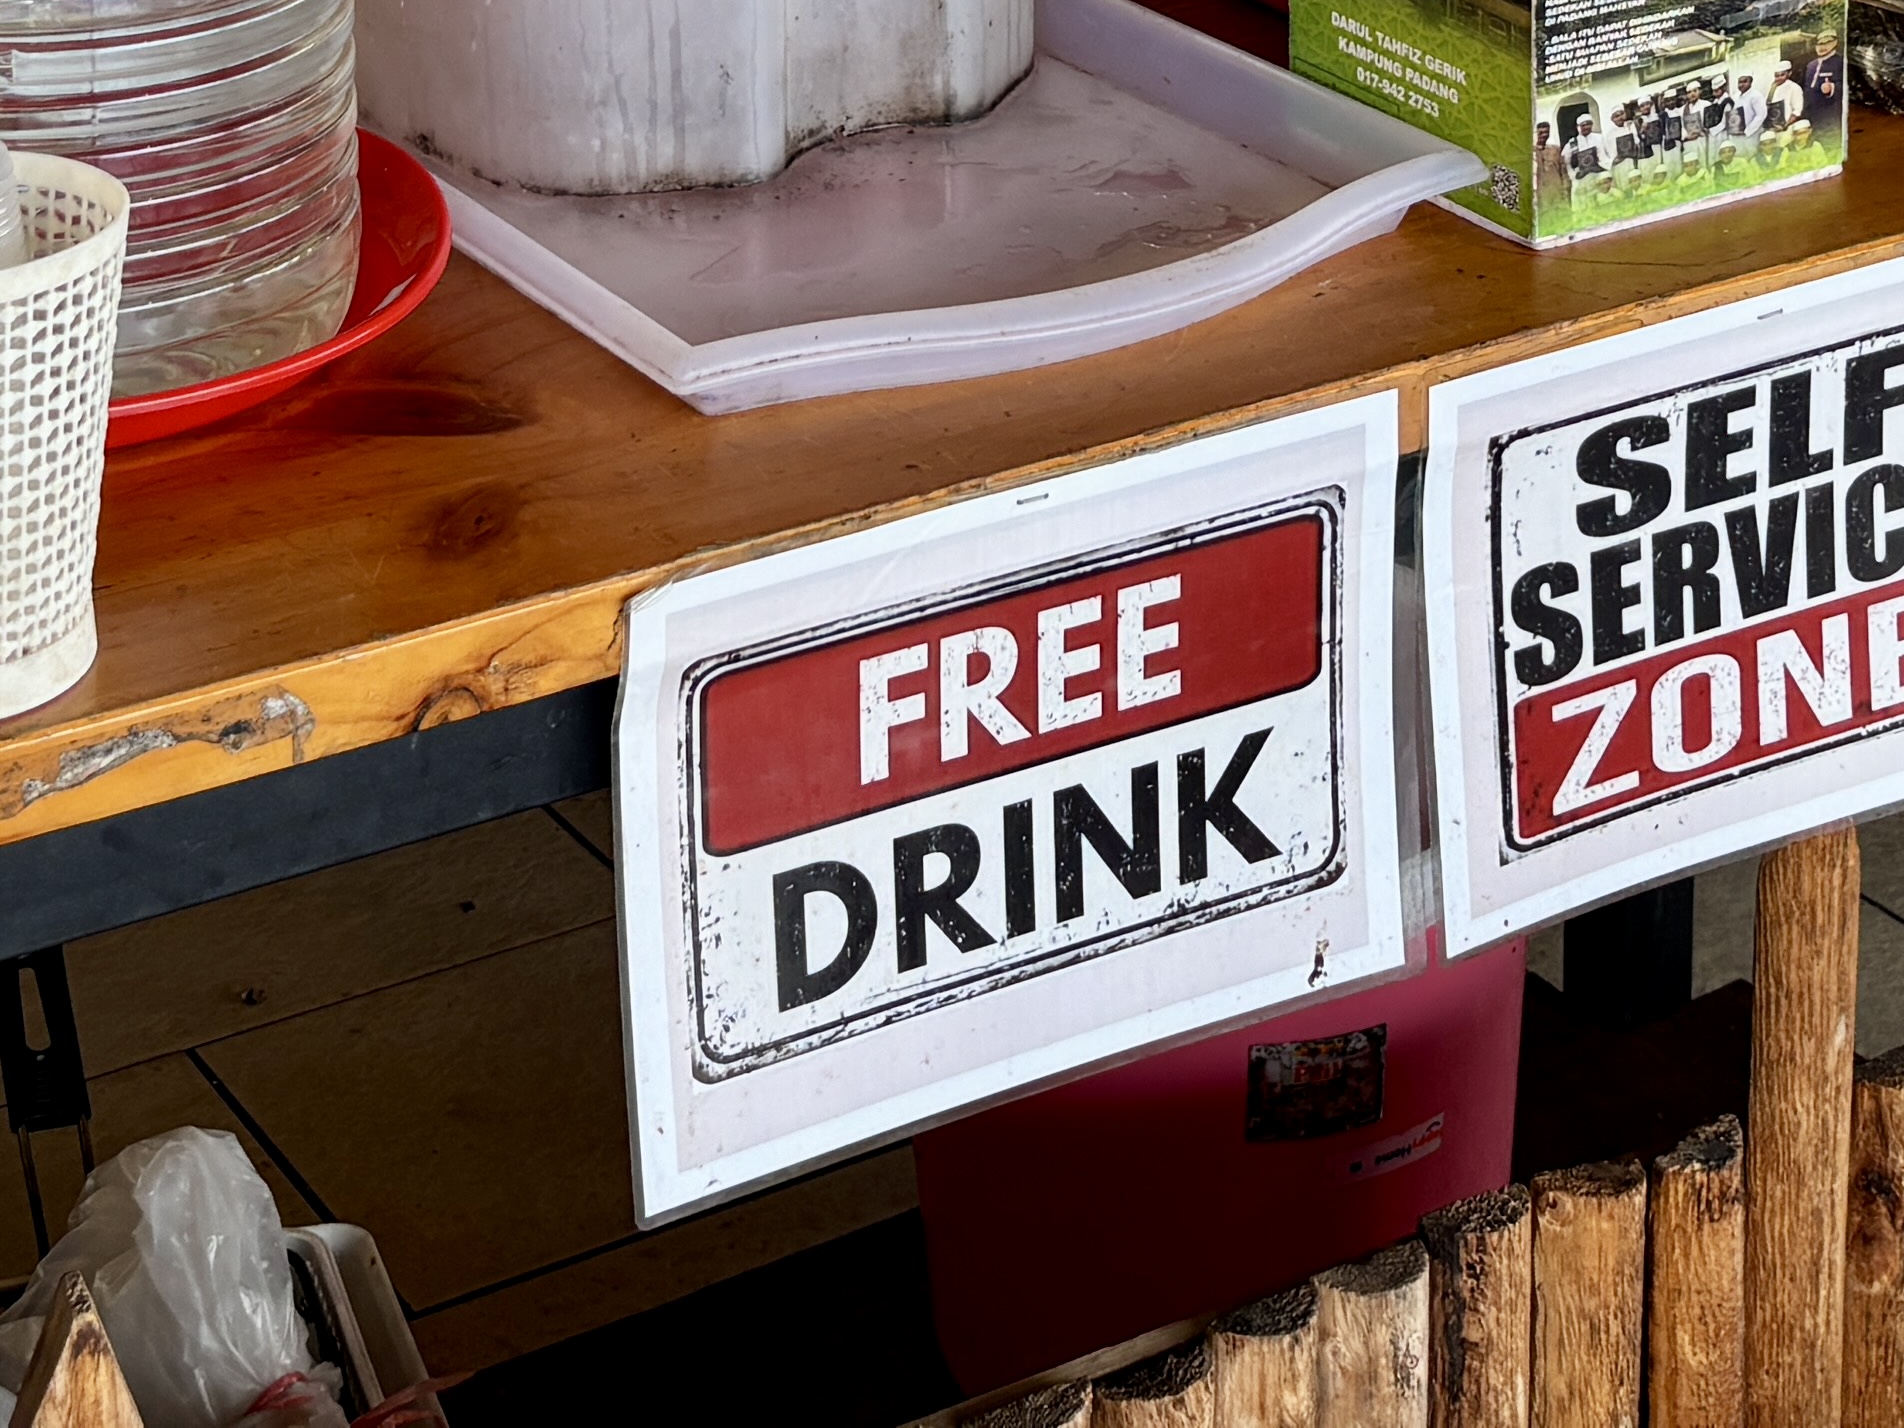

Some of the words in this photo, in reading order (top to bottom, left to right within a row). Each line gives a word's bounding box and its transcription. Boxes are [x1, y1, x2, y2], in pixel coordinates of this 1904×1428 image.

[1331, 11, 1373, 42] DARUL
[1375, 31, 1422, 65] TAHFIZ
[1425, 55, 1467, 85] GERIK
[1339, 36, 1402, 78] KAMPUNG
[1405, 68, 1459, 104] PADANG
[1357, 66, 1405, 102] 017-942
[1408, 92, 1440, 118] 2753
[859, 573, 1183, 787] FREE
[771, 726, 1284, 1013] DRINK
